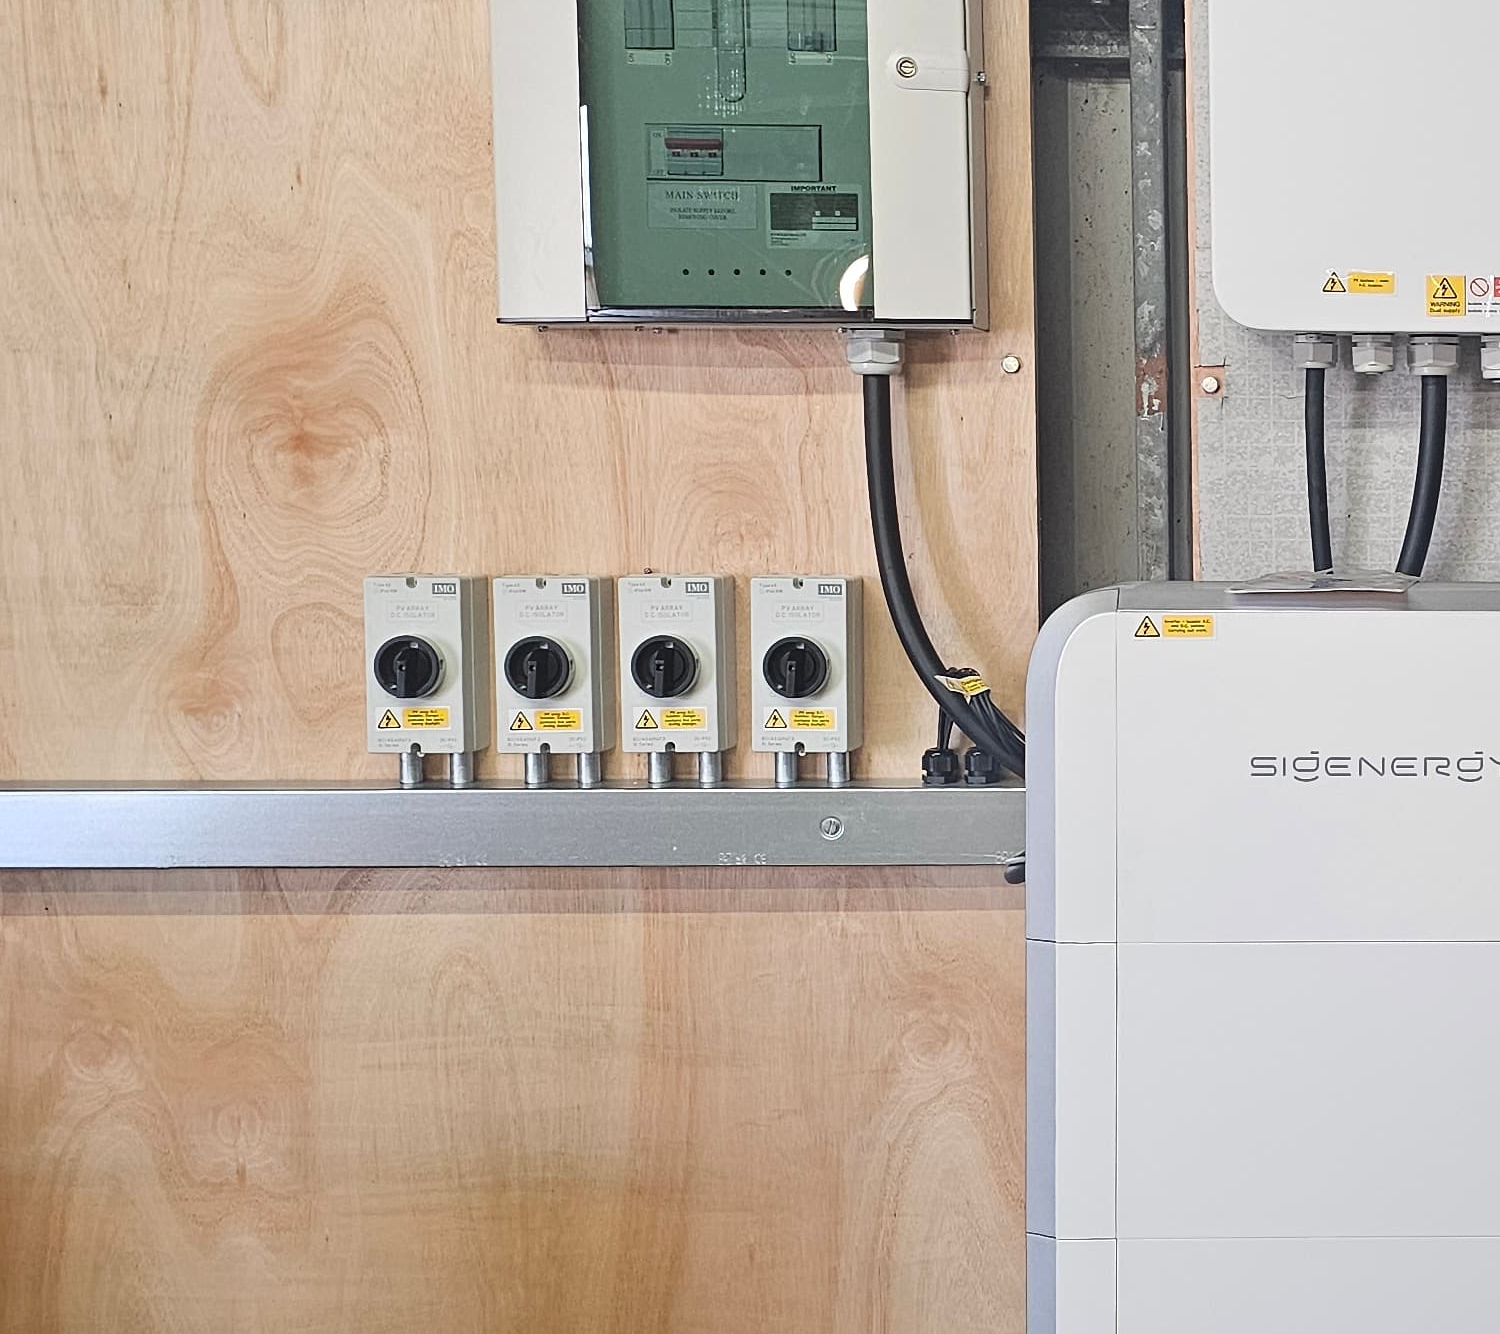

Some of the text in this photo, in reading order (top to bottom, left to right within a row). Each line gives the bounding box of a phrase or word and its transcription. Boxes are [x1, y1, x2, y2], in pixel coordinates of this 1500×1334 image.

[665, 190, 738, 200] MAIN SWITCH
[433, 584, 455, 594] IMO
[562, 584, 585, 593] IMO
[686, 583, 708, 592] IMO
[819, 585, 841, 594] IMO
